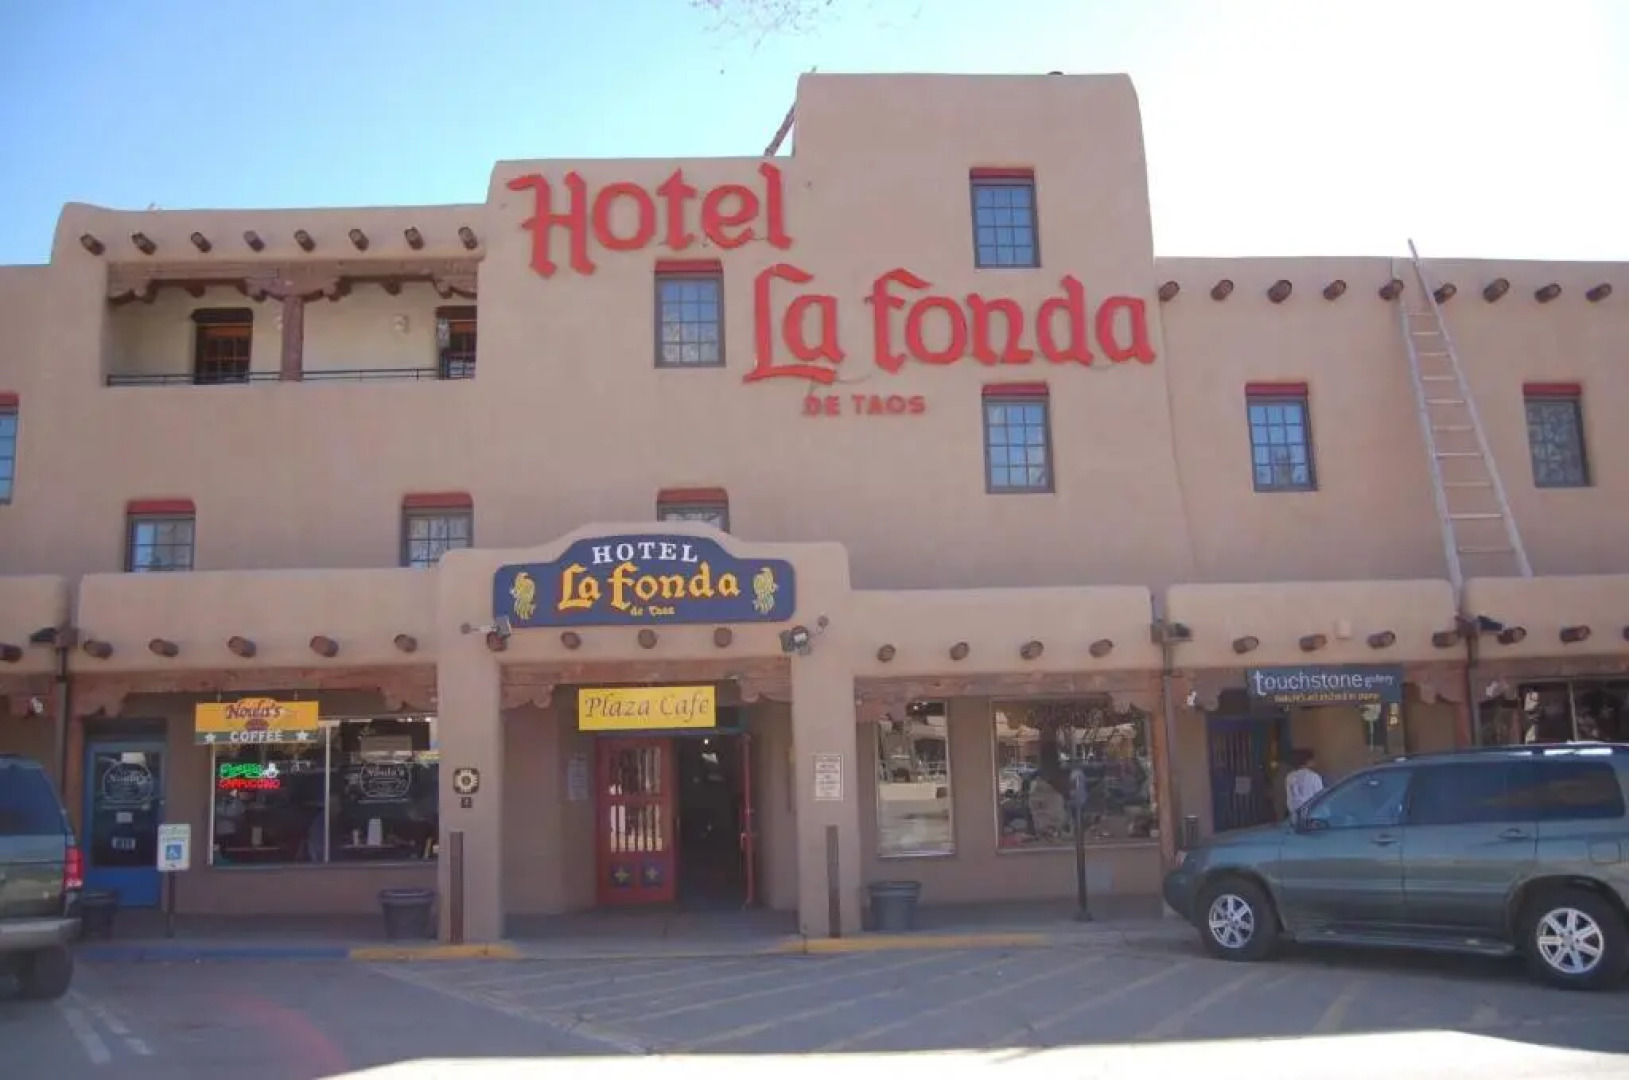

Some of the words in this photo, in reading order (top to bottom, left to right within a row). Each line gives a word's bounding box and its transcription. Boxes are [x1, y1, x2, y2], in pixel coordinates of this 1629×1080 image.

[508, 162, 793, 279] Hotel
[743, 263, 845, 385] La
[802, 394, 840, 417] DE
[850, 393, 927, 417] TAOS
[592, 542, 698, 564] HOTEL
[558, 563, 602, 610] La
[1253, 669, 1363, 696] touchstone
[584, 692, 650, 718] Plaza
[230, 730, 284, 743] COFFEE
